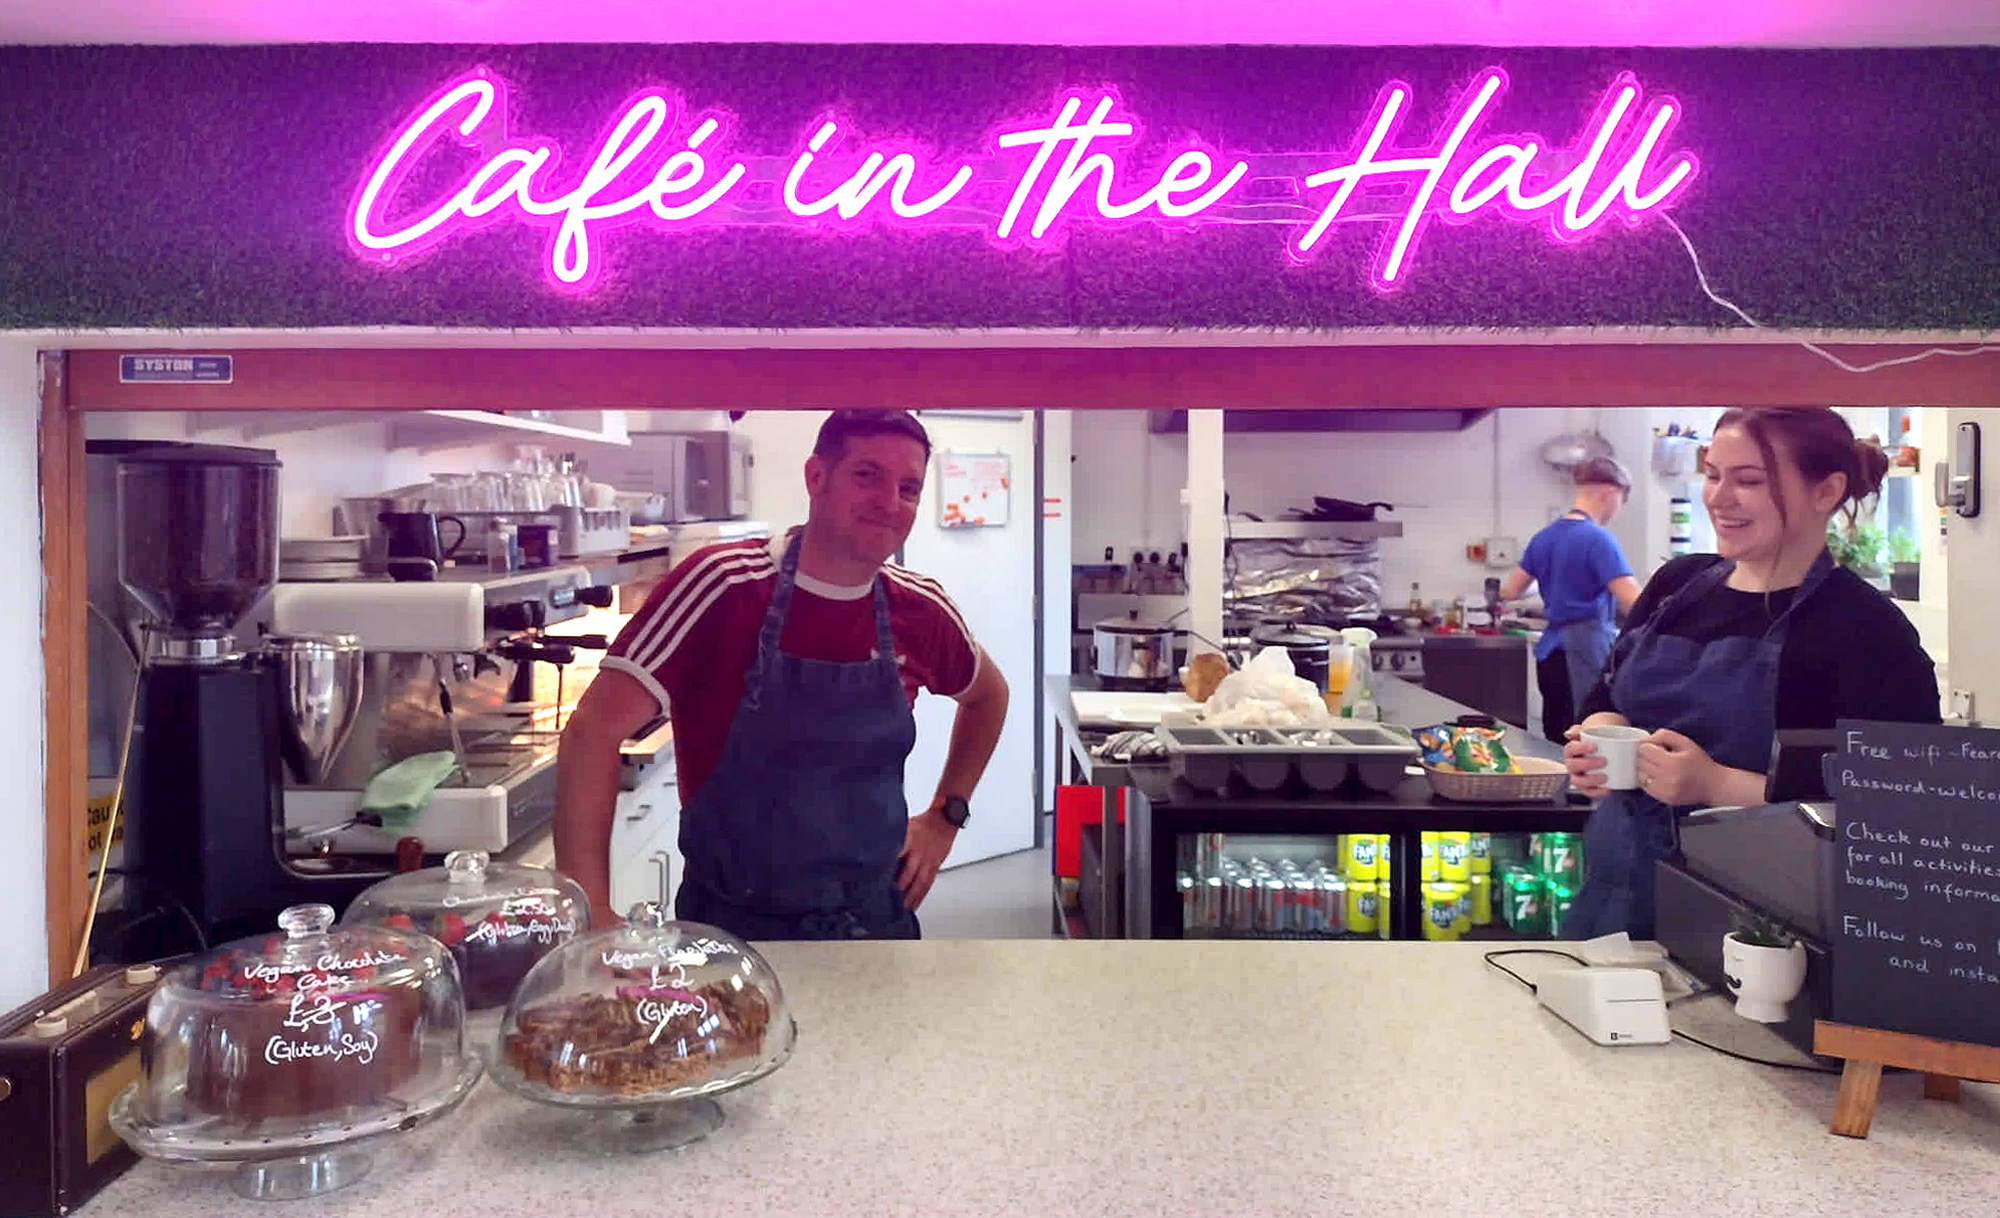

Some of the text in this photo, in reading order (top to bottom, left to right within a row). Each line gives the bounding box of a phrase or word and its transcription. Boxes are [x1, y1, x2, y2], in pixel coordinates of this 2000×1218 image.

[354, 79, 746, 283] Café
[783, 121, 972, 219] in
[1298, 75, 1693, 281] Hall
[1847, 731, 1893, 760] Free
[1903, 743, 1942, 768] wifi
[1846, 821, 1995, 854] Check out our
[1847, 846, 1874, 868] for
[1879, 851, 1903, 866] all
[1846, 869, 1910, 900] booking
[1843, 915, 1977, 953] Follow us on
[1889, 956, 2000, 985] and insta
